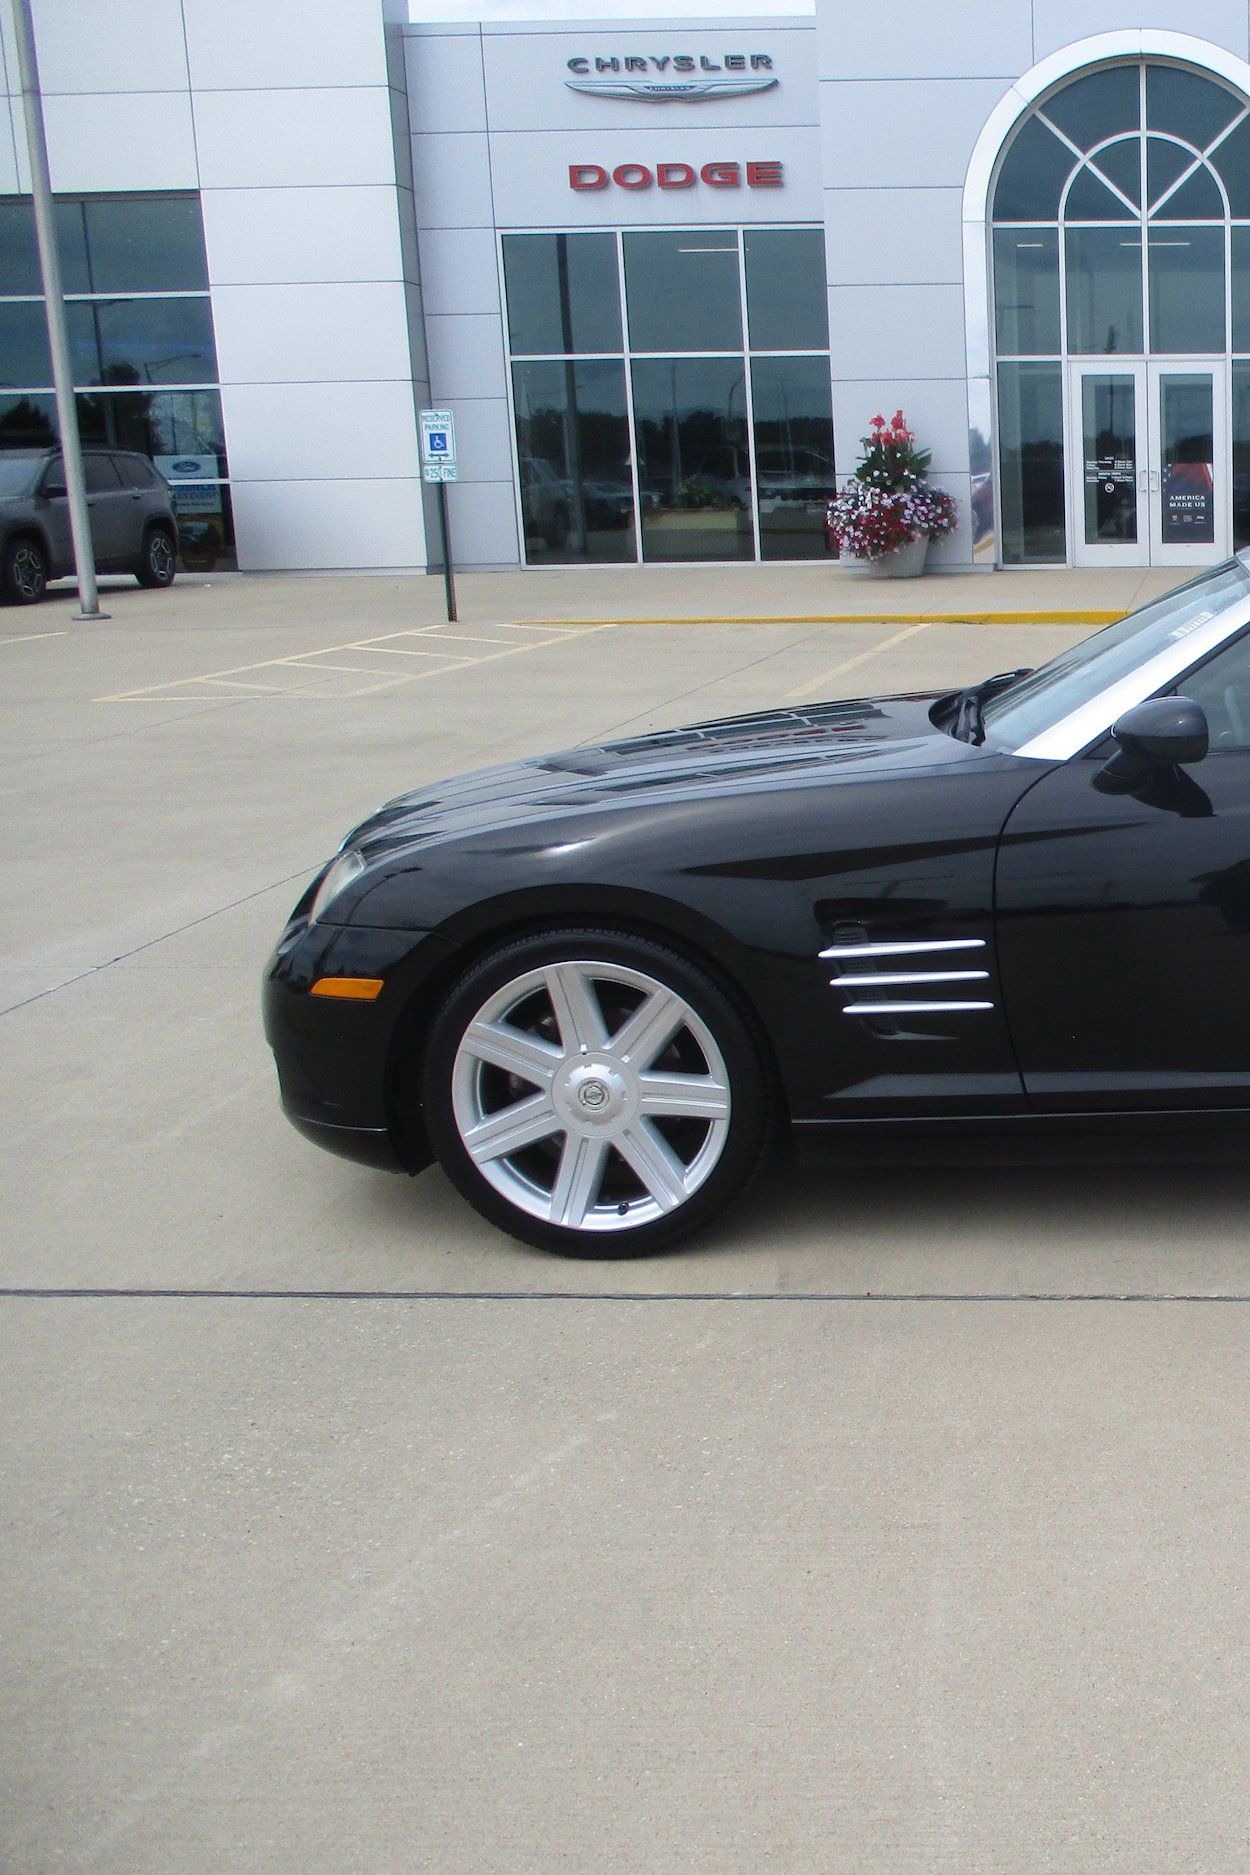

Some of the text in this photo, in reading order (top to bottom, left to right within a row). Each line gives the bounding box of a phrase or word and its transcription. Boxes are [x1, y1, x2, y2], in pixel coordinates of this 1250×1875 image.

[567, 54, 773, 73] CHRYSLER
[569, 161, 783, 189] DODGE
[422, 414, 451, 422] RESERVED
[424, 423, 450, 431] PARKING
[443, 467, 456, 478] FINE
